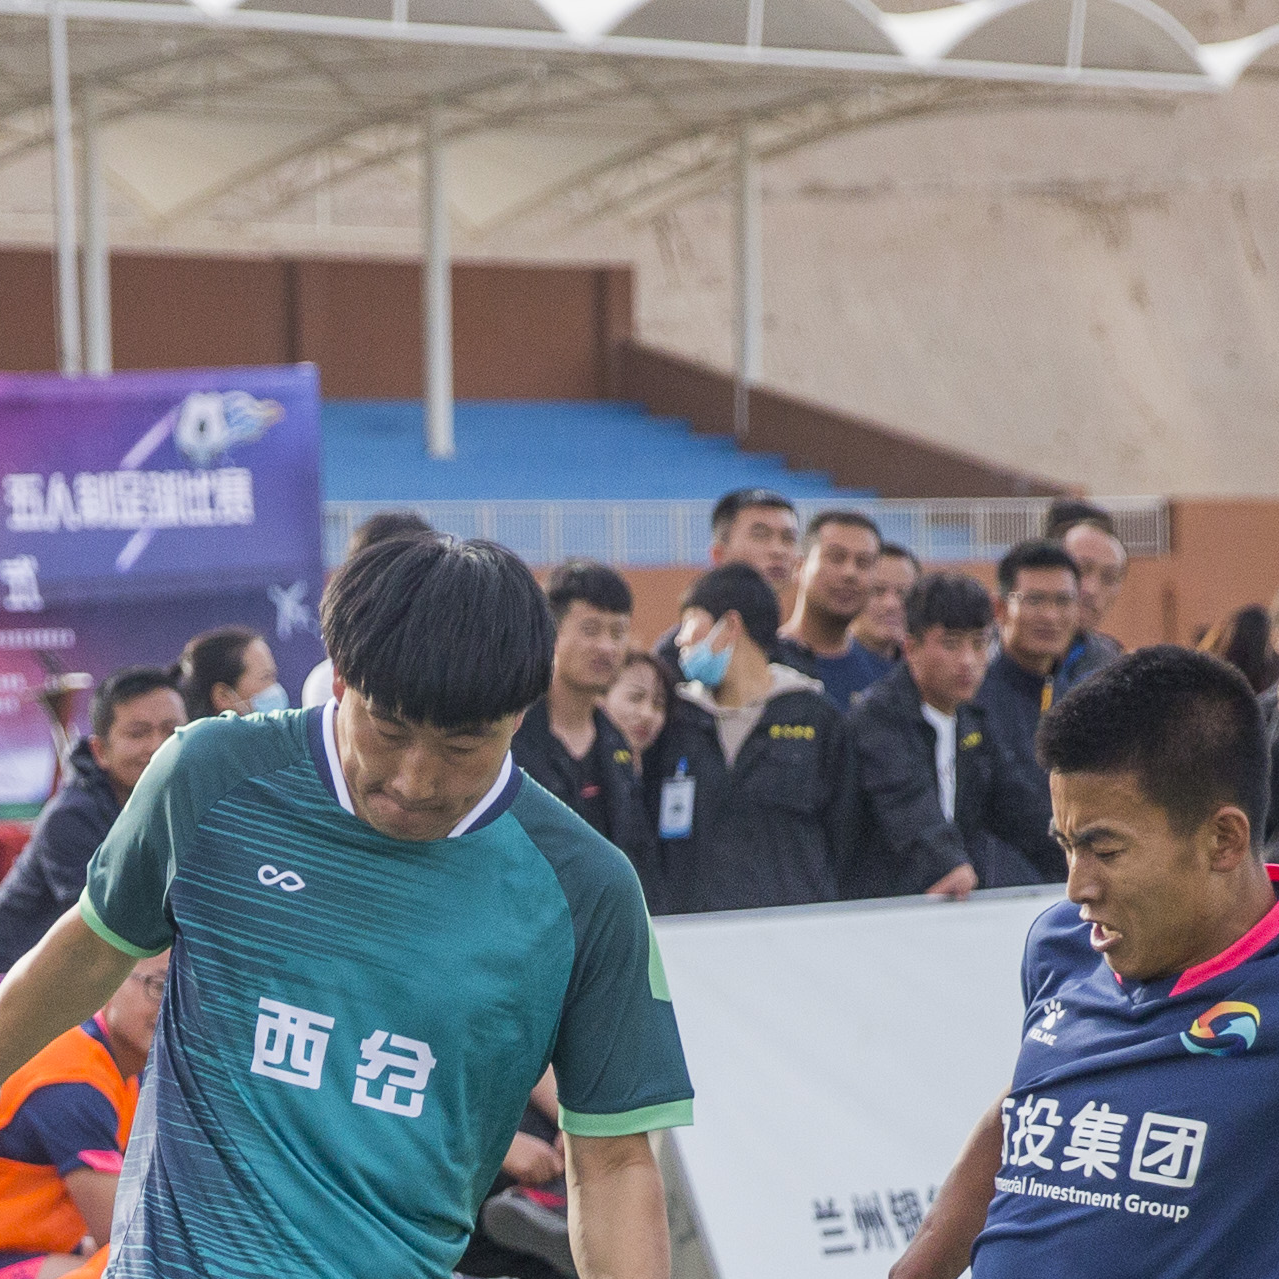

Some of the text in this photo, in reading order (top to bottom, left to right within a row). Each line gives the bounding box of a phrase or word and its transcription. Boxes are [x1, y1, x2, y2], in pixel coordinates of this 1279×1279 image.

[249, 996, 438, 1119] 西岔
[812, 1184, 939, 1255] 兰州银
[1027, 1177, 1121, 1210] Investment
[1124, 1194, 1190, 1223] Group
